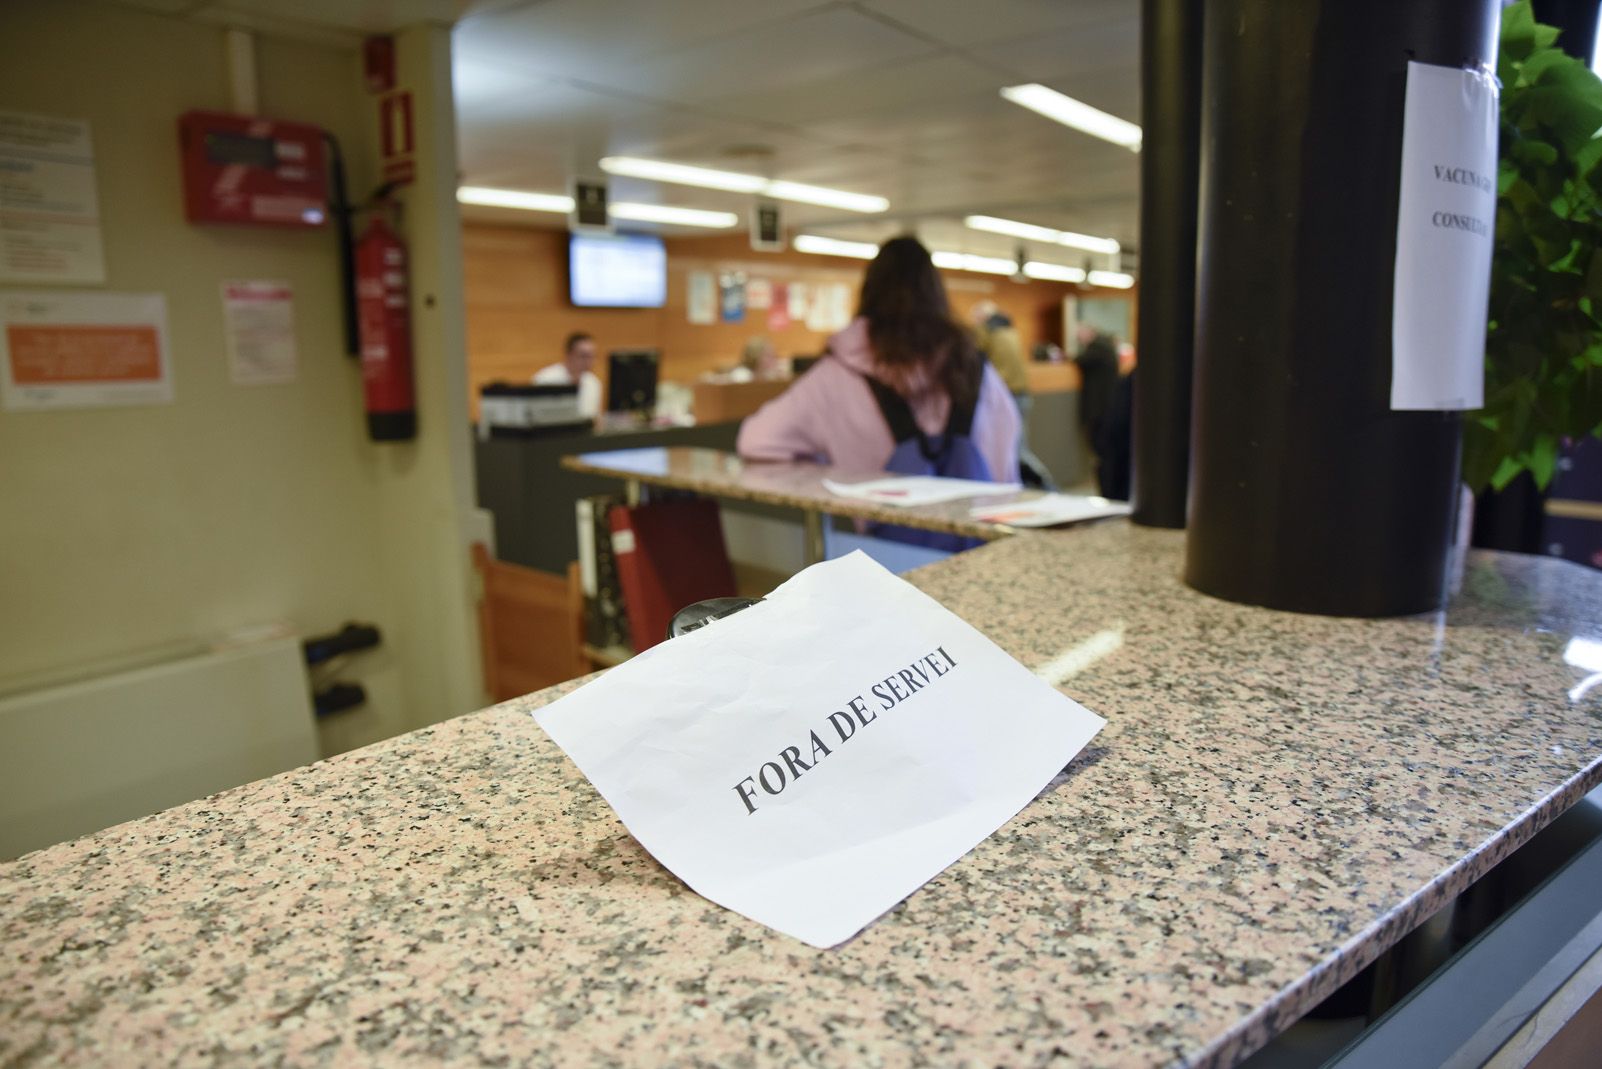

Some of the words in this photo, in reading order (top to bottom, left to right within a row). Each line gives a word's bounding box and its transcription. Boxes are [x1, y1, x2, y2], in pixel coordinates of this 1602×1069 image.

[732, 729, 832, 816] FORA
[826, 696, 877, 744] DE
[871, 646, 958, 711] SERVEI
